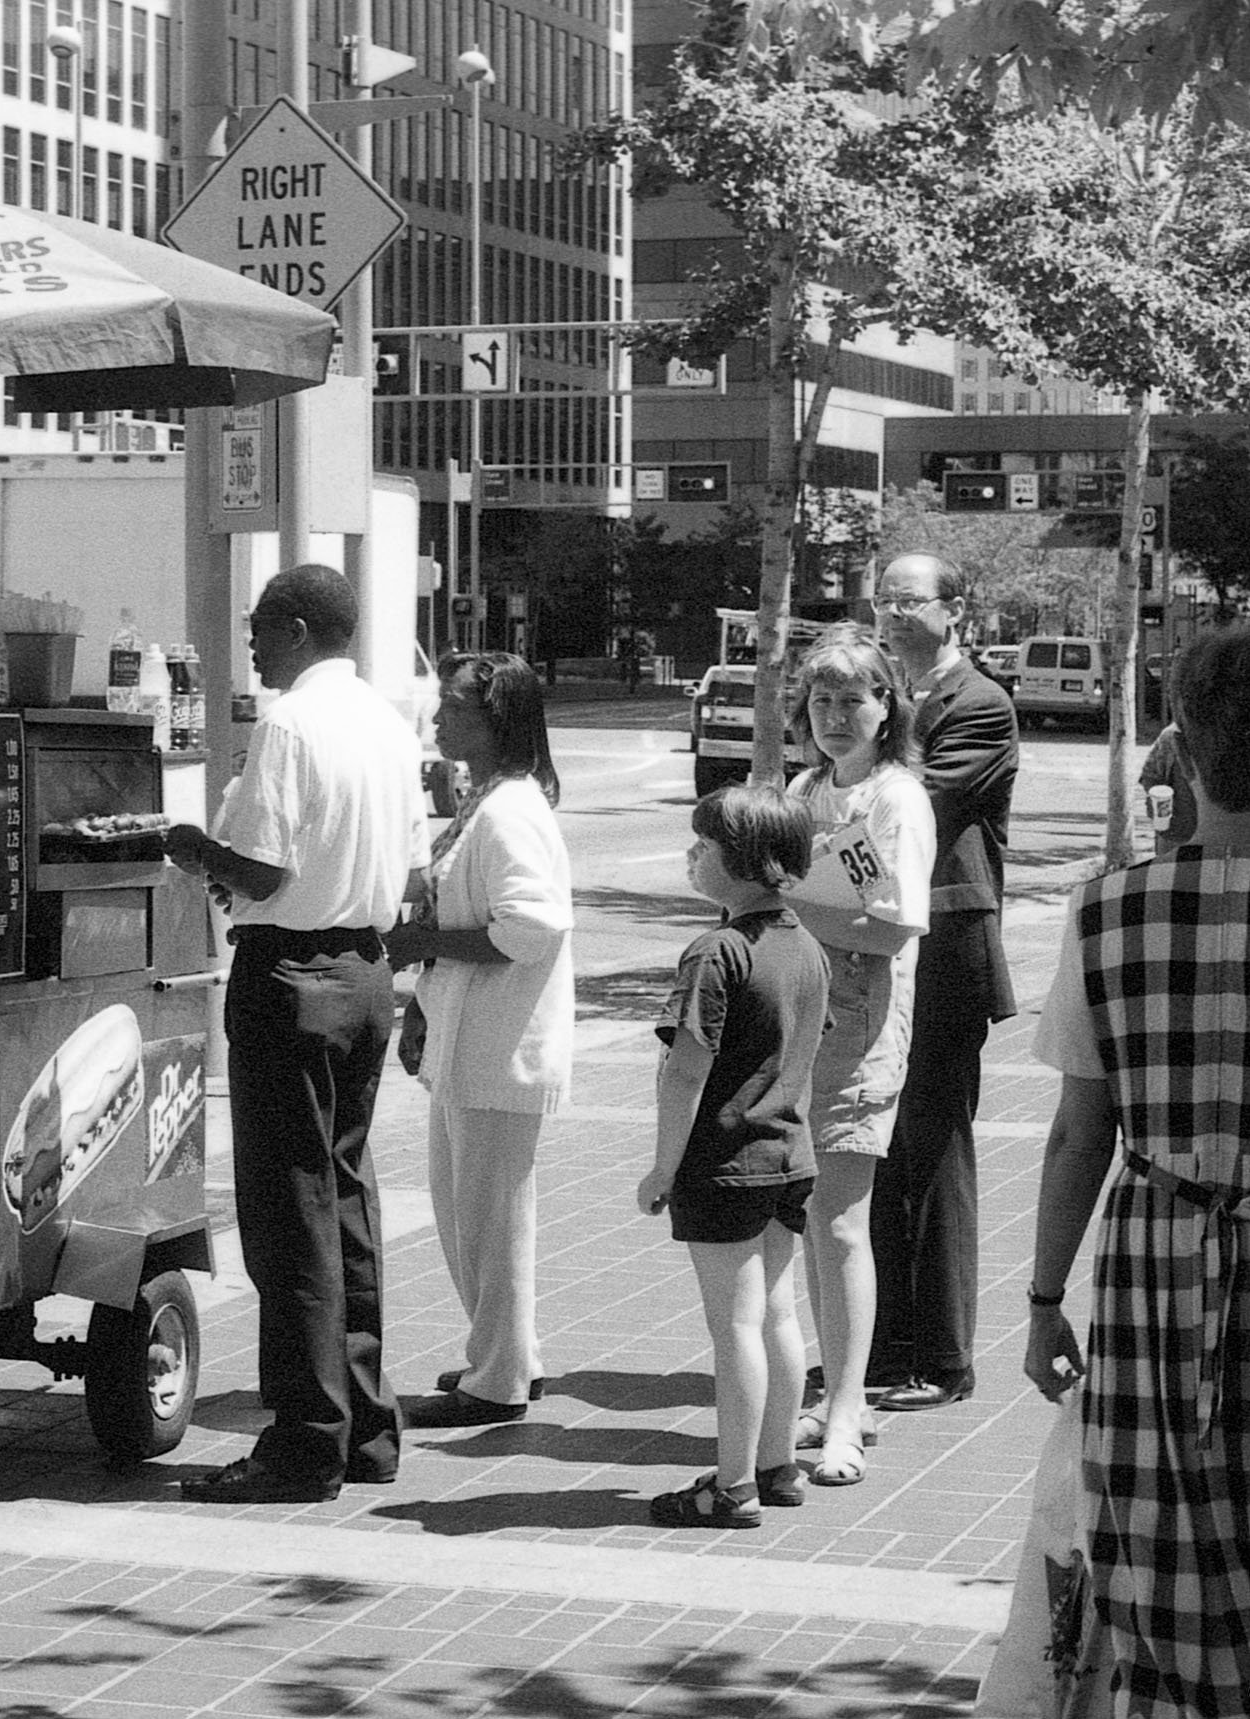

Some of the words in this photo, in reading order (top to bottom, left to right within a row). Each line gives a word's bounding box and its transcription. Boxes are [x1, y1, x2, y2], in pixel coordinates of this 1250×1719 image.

[241, 162, 327, 201] RIGHT
[237, 212, 327, 250] LANE
[231, 436, 254, 458] BUS
[229, 464, 256, 488] STOP
[1014, 477, 1034, 486] ONE
[839, 840, 879, 886] 35
[160, 1061, 182, 1106] Dr
[148, 1065, 202, 1168] Pepper
